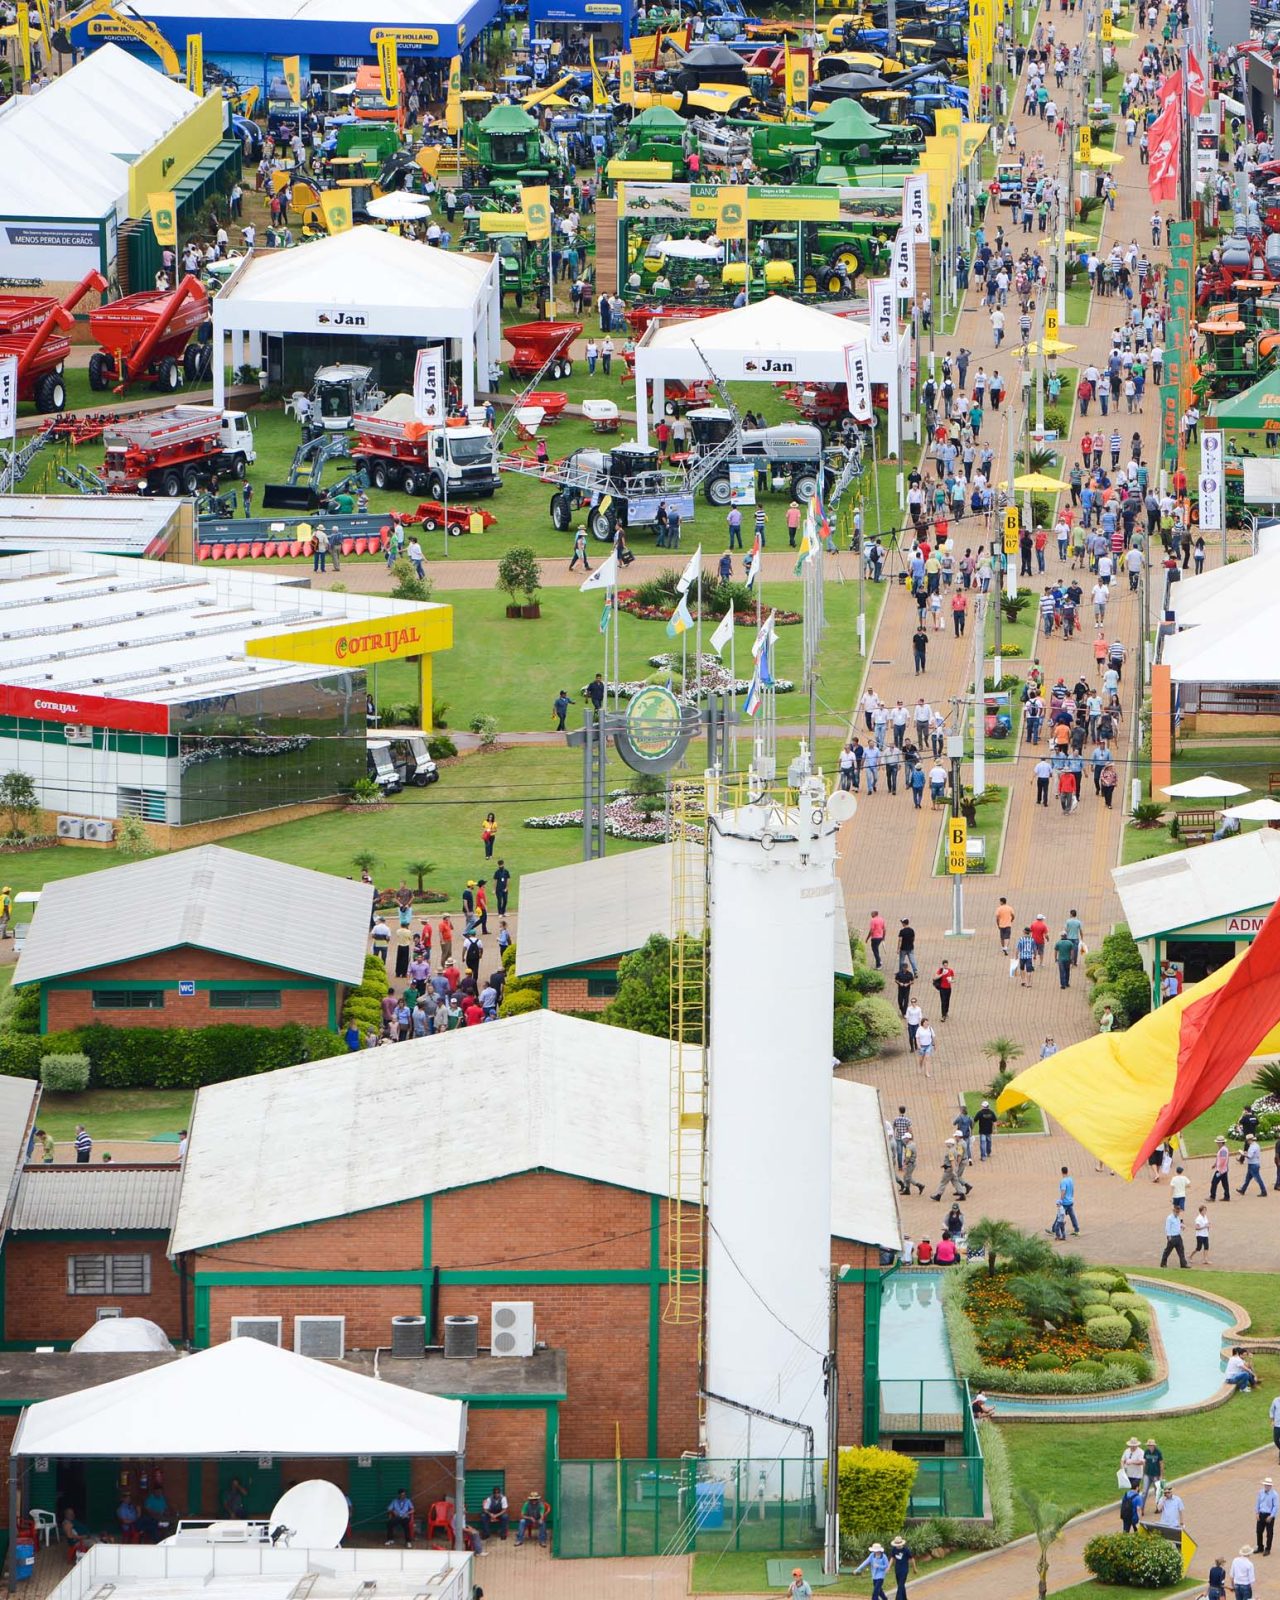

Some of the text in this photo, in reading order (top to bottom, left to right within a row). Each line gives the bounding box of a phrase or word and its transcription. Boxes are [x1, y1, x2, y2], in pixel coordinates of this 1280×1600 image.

[1104, 16, 1111, 24] B
[403, 33, 433, 41] HOLLAND
[1081, 134, 1089, 143] B
[911, 189, 922, 220] Jan
[898, 241, 909, 274] Jan
[879, 294, 892, 328] Jan
[334, 312, 366, 326] Jan
[1048, 317, 1056, 328] B
[761, 359, 793, 372] Jan
[424, 365, 436, 400] Jan
[854, 359, 864, 393] Jan
[1, 375, 10, 406] Jan
[1007, 516, 1016, 529] B
[1006, 540, 1017, 548] 07
[335, 627, 421, 659] COTRIJAL
[34, 699, 79, 713] COTRIJAL
[953, 829, 964, 844] B
[951, 857, 965, 867] 08
[180, 984, 193, 992] WC
